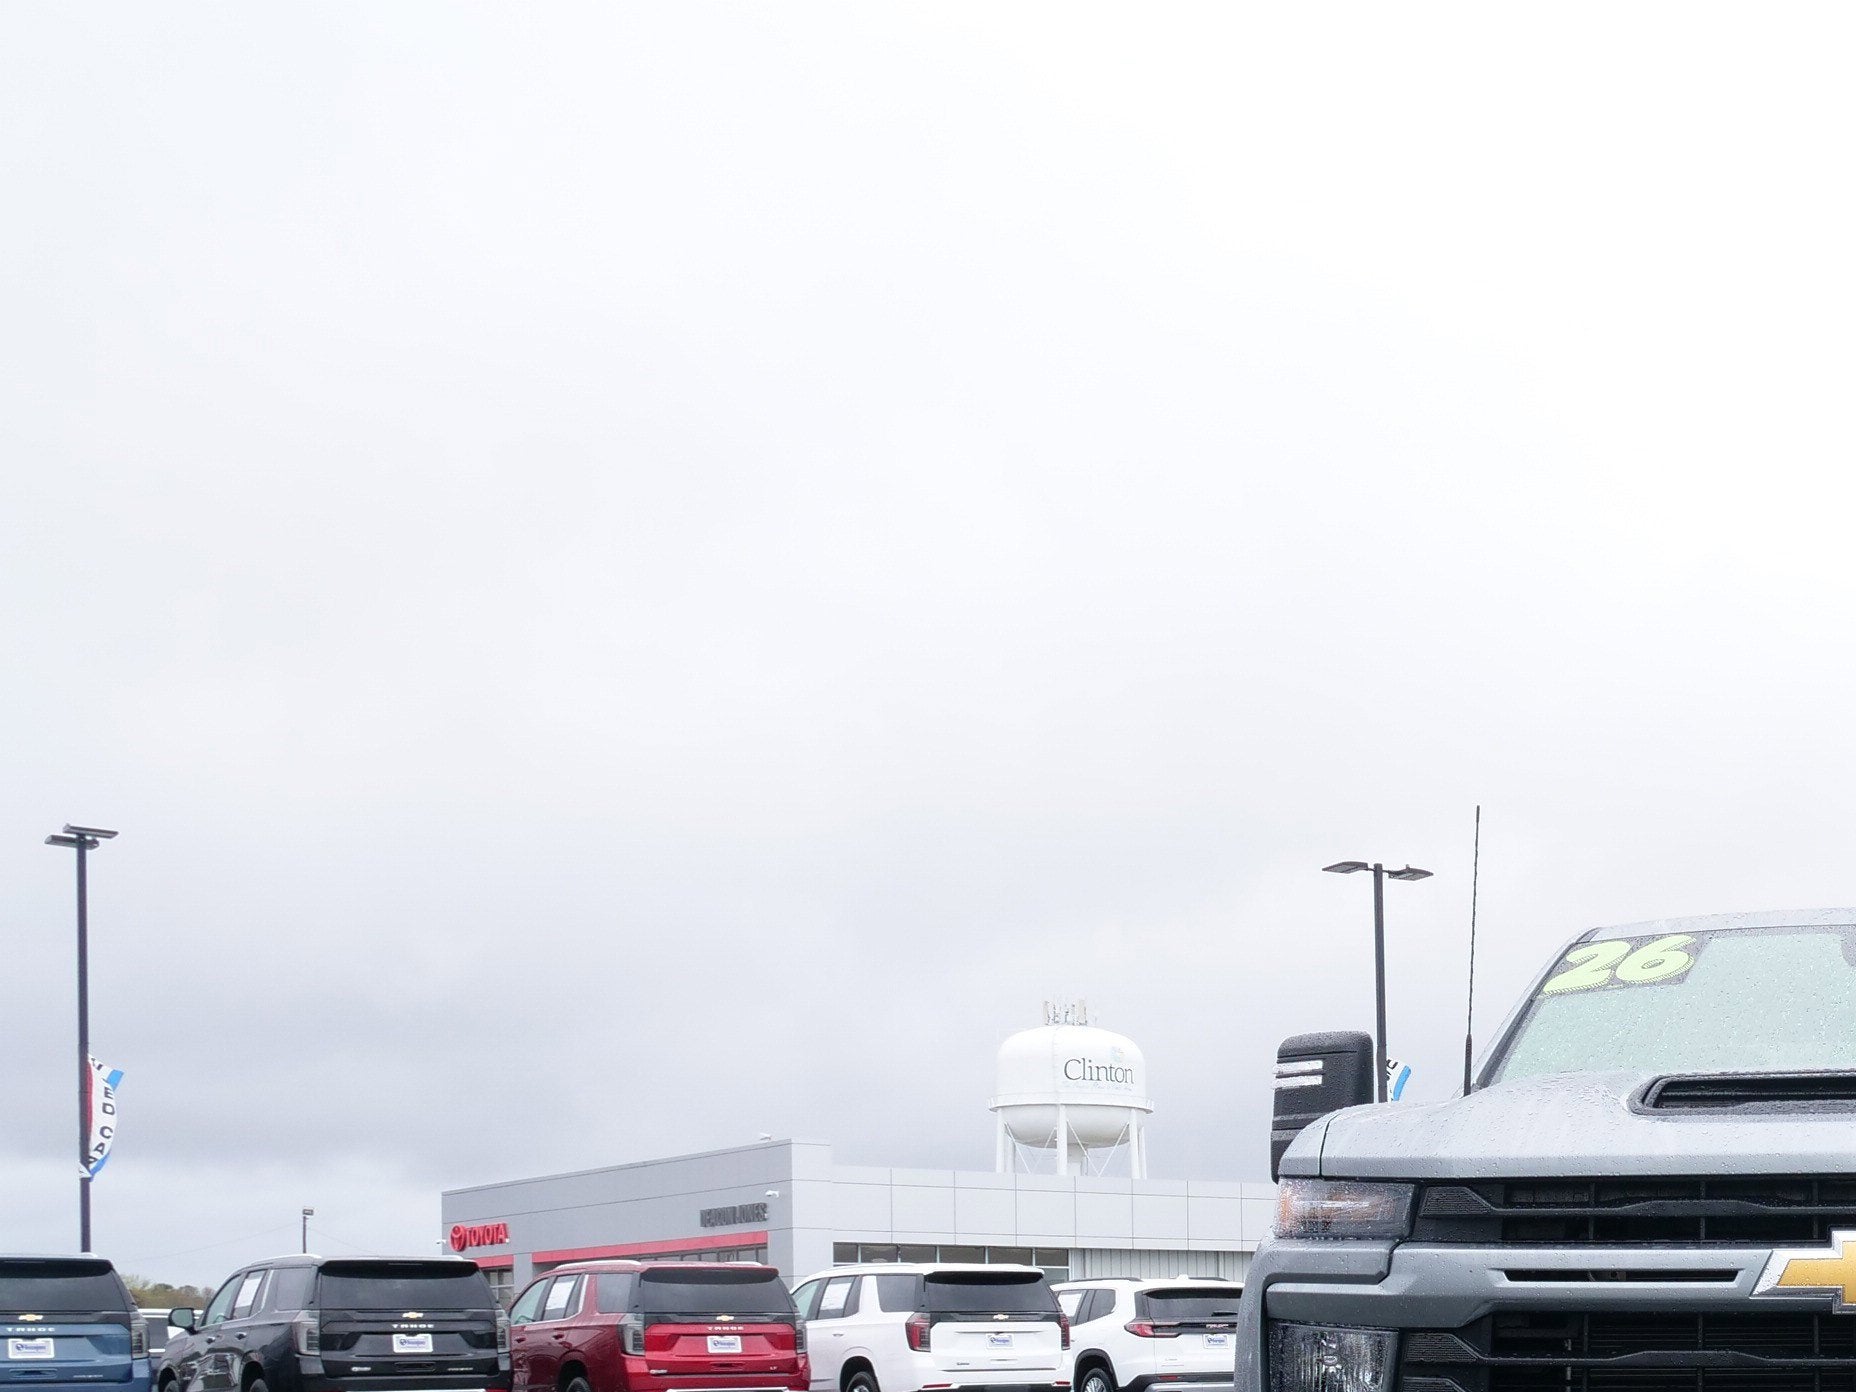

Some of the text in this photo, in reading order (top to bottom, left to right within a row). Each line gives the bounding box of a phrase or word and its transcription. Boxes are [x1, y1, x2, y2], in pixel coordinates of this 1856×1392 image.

[1538, 934, 1697, 997] 26
[1064, 1058, 1134, 1084] Clinton
[466, 1223, 508, 1247] TOYOTA
